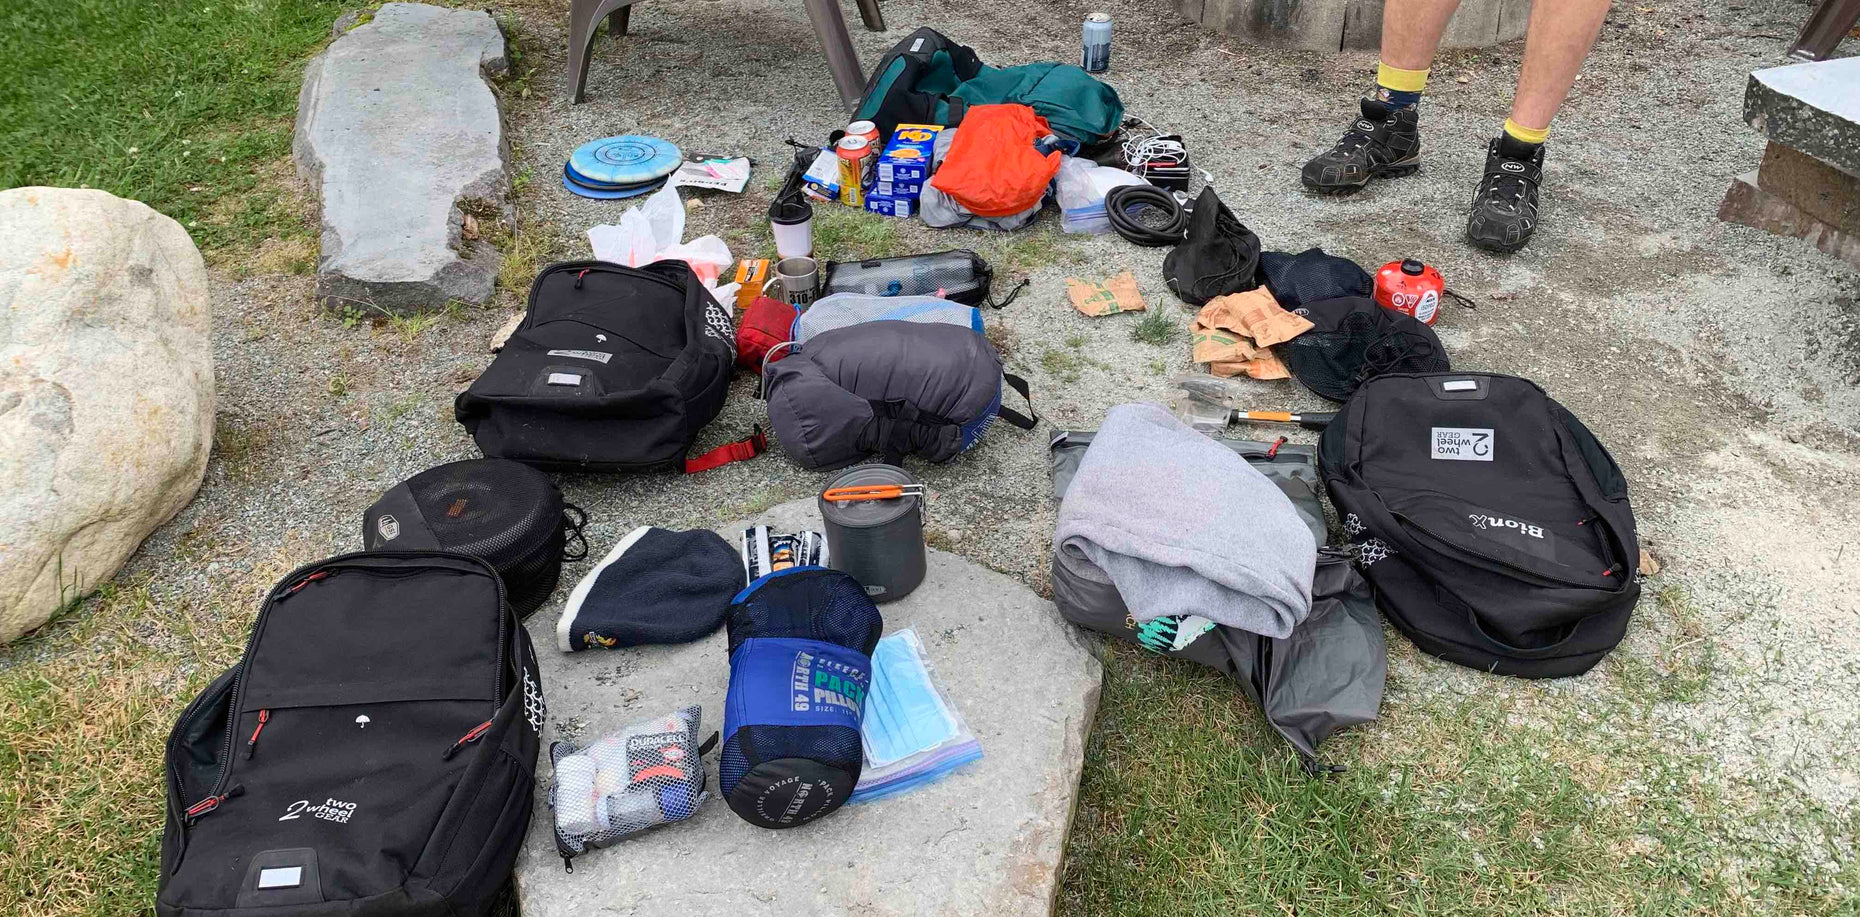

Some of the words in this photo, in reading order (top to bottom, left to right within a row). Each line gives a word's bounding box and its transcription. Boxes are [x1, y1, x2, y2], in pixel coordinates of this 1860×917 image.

[898, 130, 932, 142] KD
[1436, 431, 1461, 439] GEAR
[1437, 438, 1471, 447] wheel
[1471, 432, 1490, 457] 2
[1437, 446, 1460, 456] two
[795, 651, 814, 691] NORTH
[794, 694, 810, 711] 49
[631, 734, 683, 746] DURACELL
[764, 775, 800, 795] VOYAGE
[326, 797, 357, 810] two
[787, 782, 813, 815] NORTH
[278, 799, 309, 822] 2
[306, 803, 354, 818] wheel
[314, 811, 349, 824] GEAR
